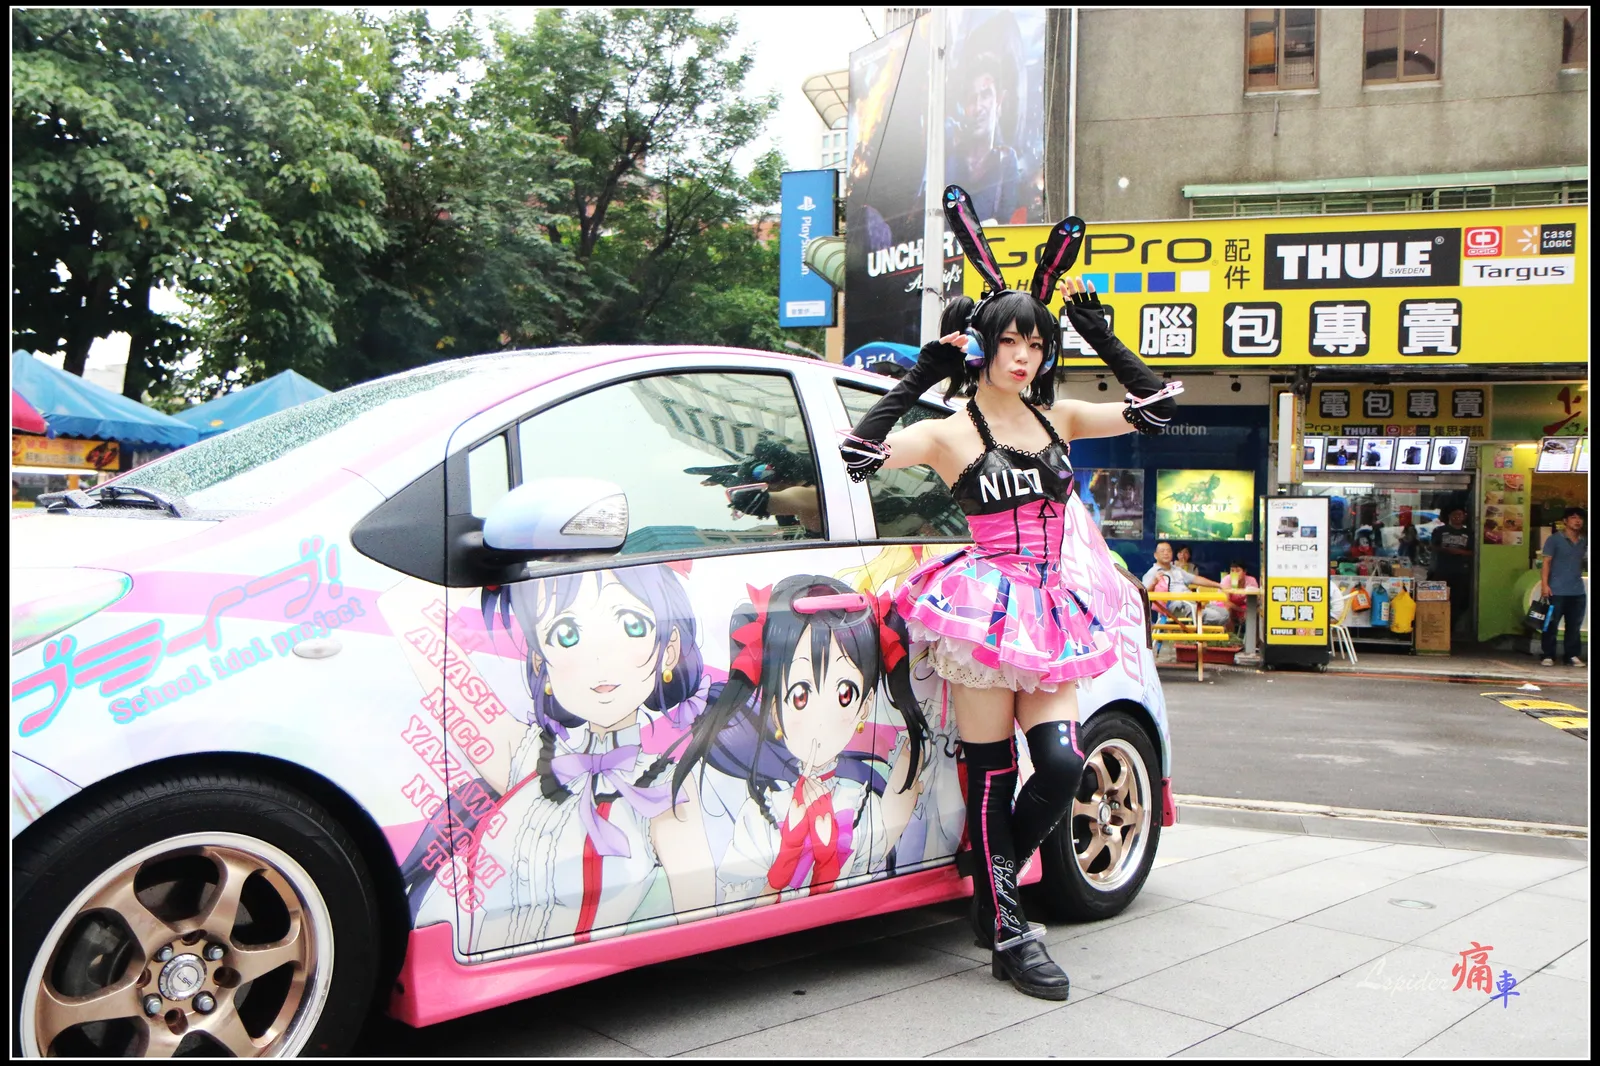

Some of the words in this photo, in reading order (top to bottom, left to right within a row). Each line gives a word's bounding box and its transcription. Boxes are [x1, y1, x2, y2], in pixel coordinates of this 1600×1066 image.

[985, 233, 1212, 268] GPro
[1543, 229, 1573, 239] case
[1543, 239, 1572, 248] LOGIC
[1224, 238, 1251, 290] 配件
[1276, 240, 1433, 280] THULE
[1389, 266, 1426, 275] SWEDEN
[1472, 263, 1566, 282] Targus
[1318, 390, 1485, 418] 電包專賣
[1344, 426, 1379, 436] THULE
[108, 664, 212, 725] School
[209, 636, 274, 681] idol
[271, 597, 367, 658] project
[404, 626, 507, 725] AYASE
[420, 686, 495, 765] NICO
[400, 714, 508, 839] YAZAWA
[401, 773, 506, 889] NOZOMI
